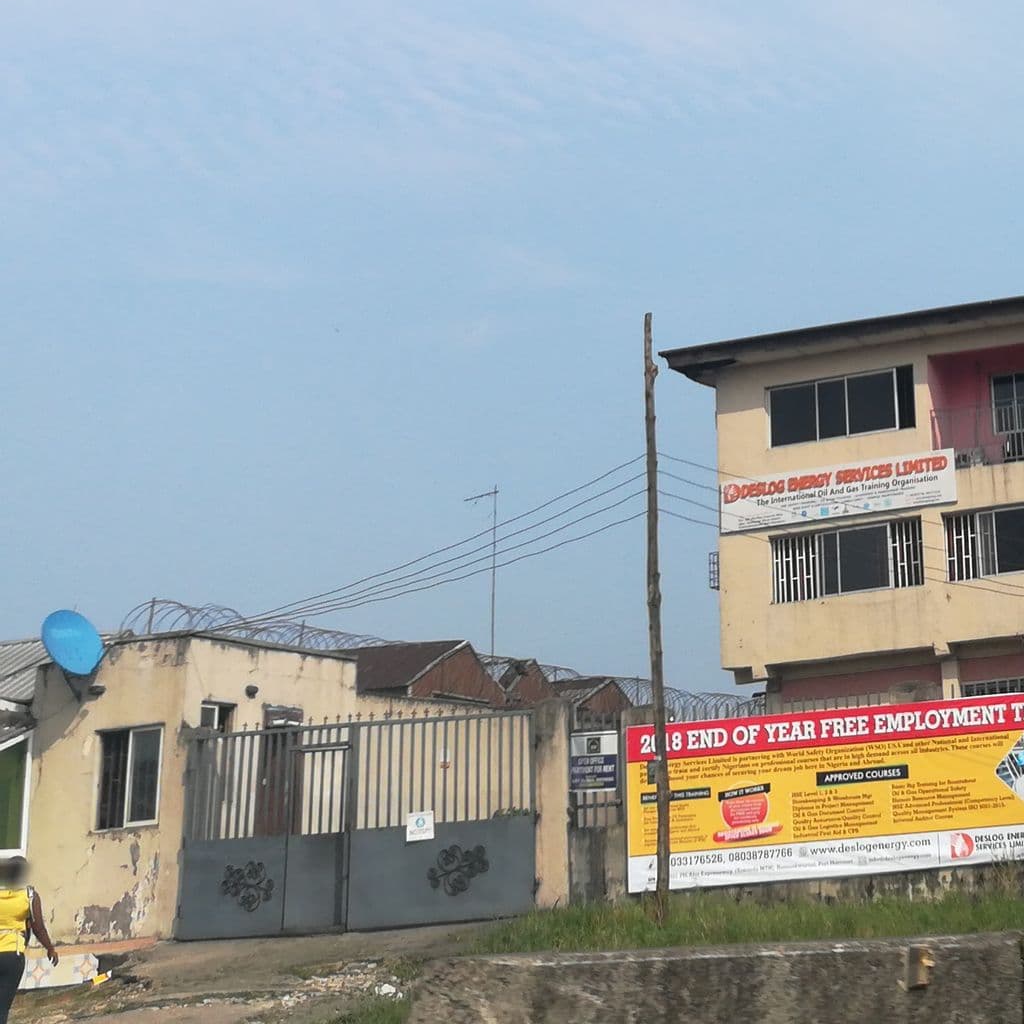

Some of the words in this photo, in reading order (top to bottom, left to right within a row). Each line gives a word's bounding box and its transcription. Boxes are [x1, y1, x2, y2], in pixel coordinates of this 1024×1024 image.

[786, 472, 832, 492] ENERGY
[835, 463, 892, 484] SERVICES
[895, 455, 947, 476] LIMITED
[756, 498, 769, 506] The
[770, 491, 815, 504] International
[817, 489, 828, 497] Oil
[829, 486, 844, 495] And
[845, 485, 858, 493] Gas
[861, 481, 889, 490] Training
[891, 475, 938, 487] Organisation
[686, 728, 728, 749] END
[732, 724, 760, 745] OF
[764, 720, 816, 742] YEAR
[820, 715, 869, 737] FREE
[874, 704, 1005, 733] EMPLOYMENT
[738, 754, 770, 763] partnering
[825, 746, 864, 754] Organization
[824, 770, 863, 783] APPROVED
[865, 768, 901, 779] COURSES
[974, 833, 1004, 842] DESLOG
[975, 841, 1006, 850] SERVICES
[728, 847, 792, 861] 08038787766
[810, 839, 930, 854] www.deslogenergy.com
